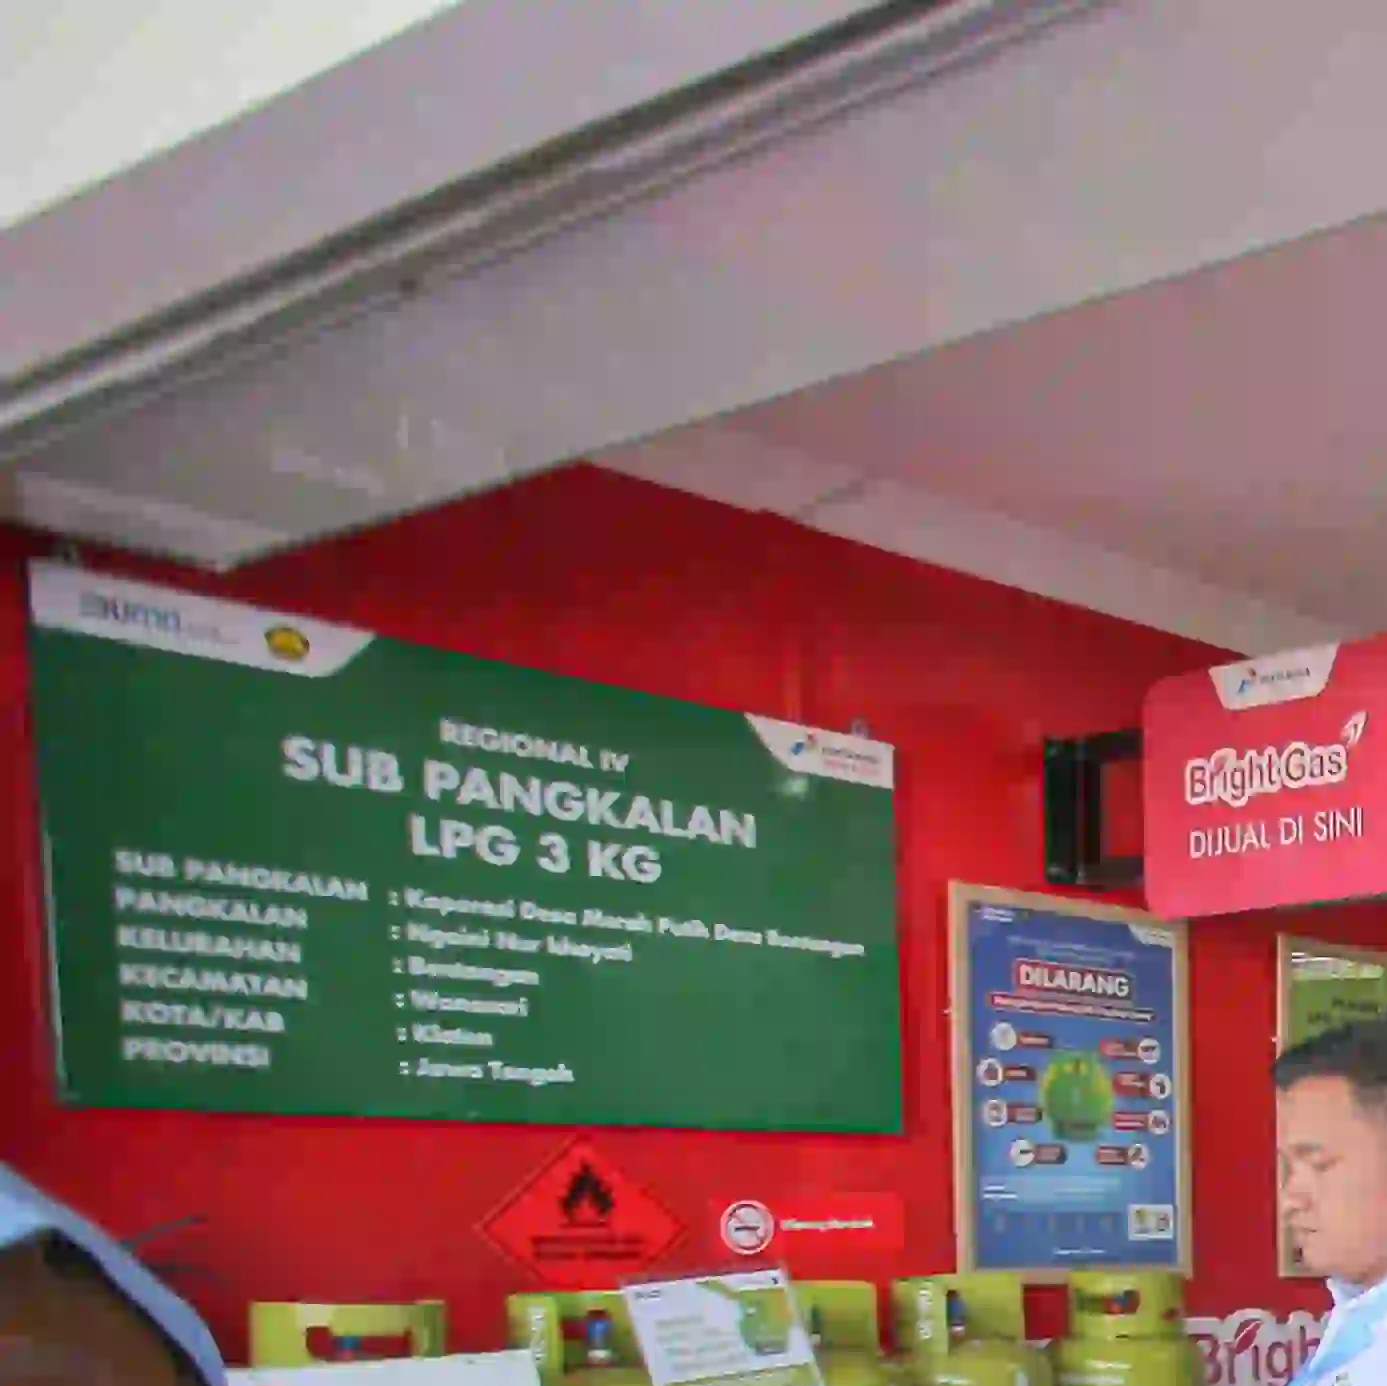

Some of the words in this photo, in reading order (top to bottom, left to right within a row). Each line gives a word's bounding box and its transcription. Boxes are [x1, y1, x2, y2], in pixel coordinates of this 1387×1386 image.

[439, 717, 595, 769] REGIONAL
[600, 748, 630, 772] IV
[281, 735, 404, 793] SUB
[423, 758, 757, 849] PANGKALAN
[1187, 748, 1279, 804] Bright
[1282, 742, 1346, 789] Gas
[409, 812, 522, 867] LPG
[535, 831, 571, 874] 3
[587, 839, 663, 884] KG
[1189, 822, 1271, 859] DIJUAL
[1279, 814, 1303, 845] DI
[1313, 806, 1364, 841] SINI
[114, 850, 176, 878] SUB
[184, 857, 369, 901] PANGKALAN
[114, 886, 308, 930] PANGKALAN
[117, 925, 301, 963] KELURAHAN
[119, 962, 308, 1000] KECAMATAN
[1018, 963, 1130, 998] DILARANG
[121, 1036, 270, 1067] PROVINSI
